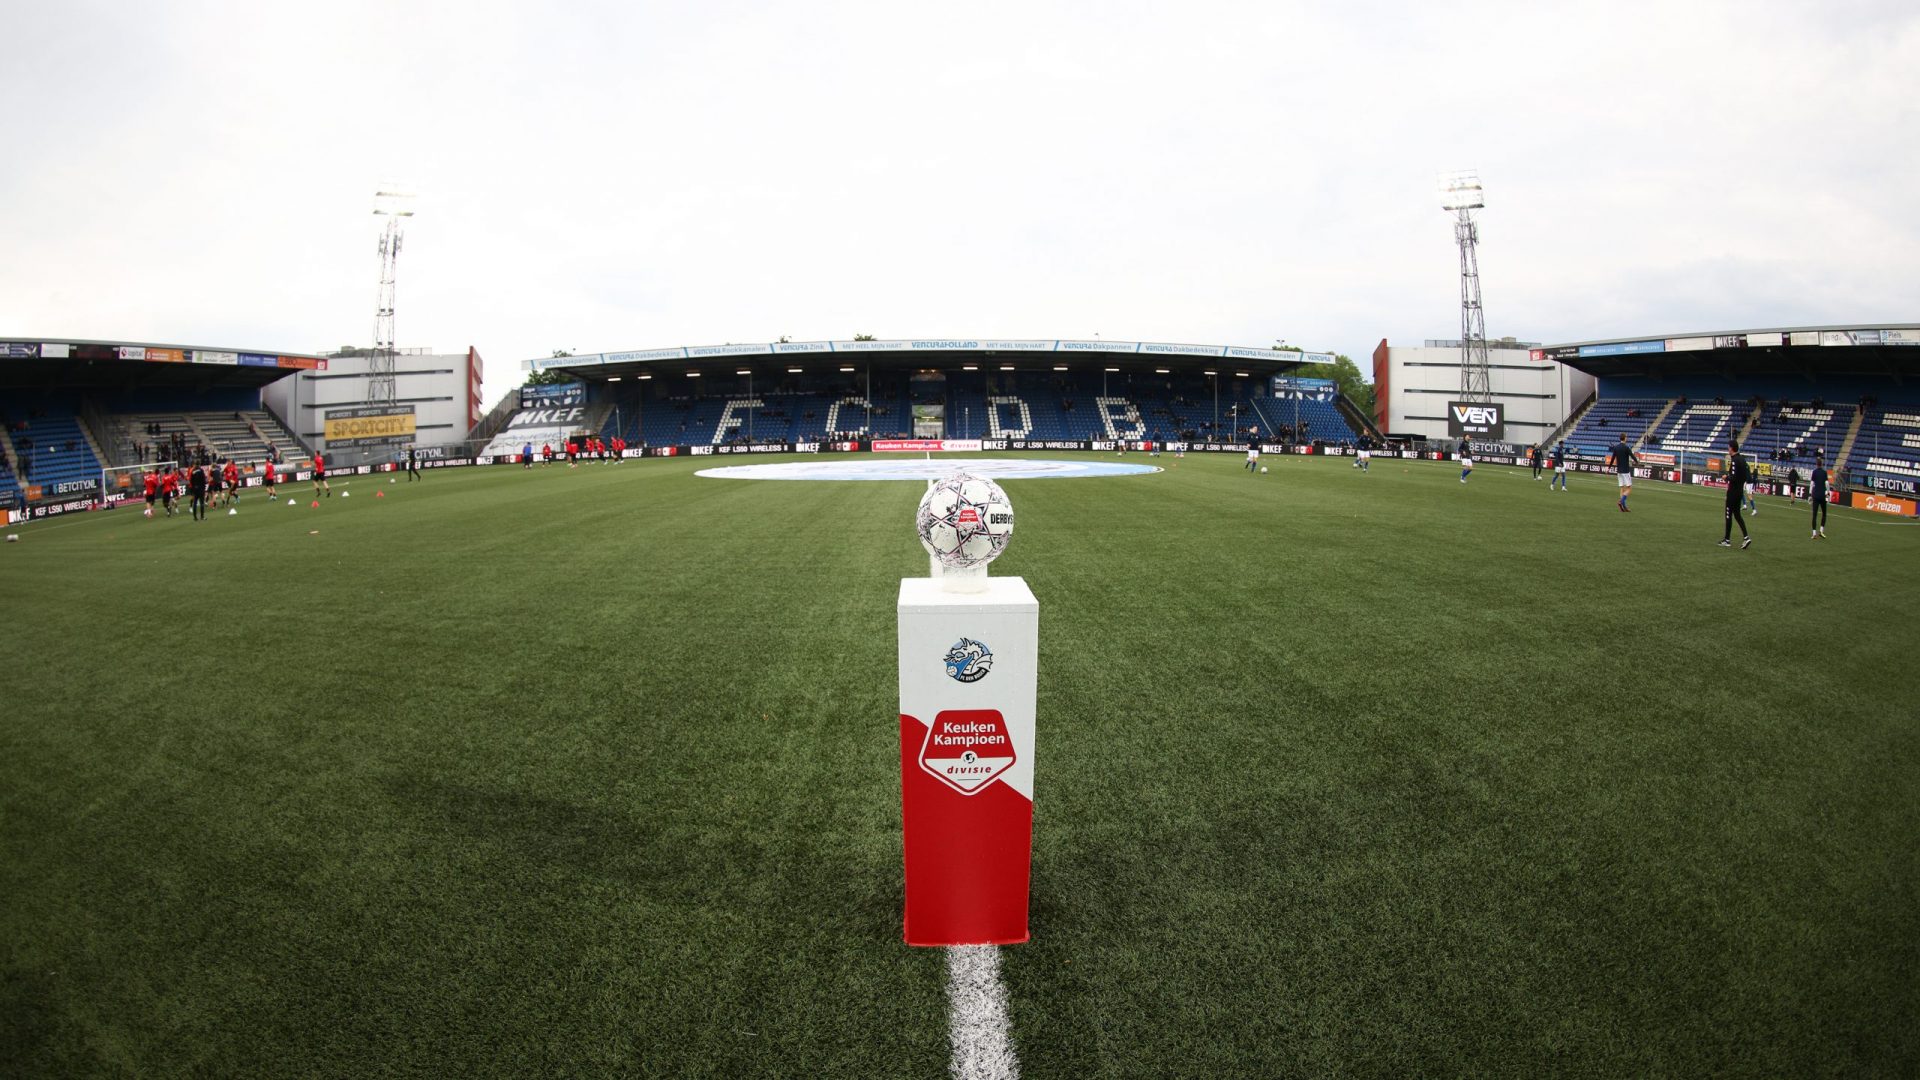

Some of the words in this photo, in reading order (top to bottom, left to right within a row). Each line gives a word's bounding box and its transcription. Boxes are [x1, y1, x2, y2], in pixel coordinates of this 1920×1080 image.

[635, 350, 681, 360] Dakbedekking
[1173, 345, 1219, 355] Dakbedekking
[333, 418, 407, 437] SPORTCITY
[750, 444, 782, 452] WIRELESS
[902, 442, 938, 450] Kampioen
[1222, 443, 1250, 451] WIRELESS
[1468, 441, 1516, 454] BETCITY.NL
[400, 448, 444, 461] BECITY.NL
[58, 479, 97, 494] BETCITY.NL
[1873, 477, 1916, 494] BETCITY.NL
[943, 721, 996, 734] Keuken
[934, 733, 1005, 748] Kampioen
[946, 766, 992, 774] divisie
